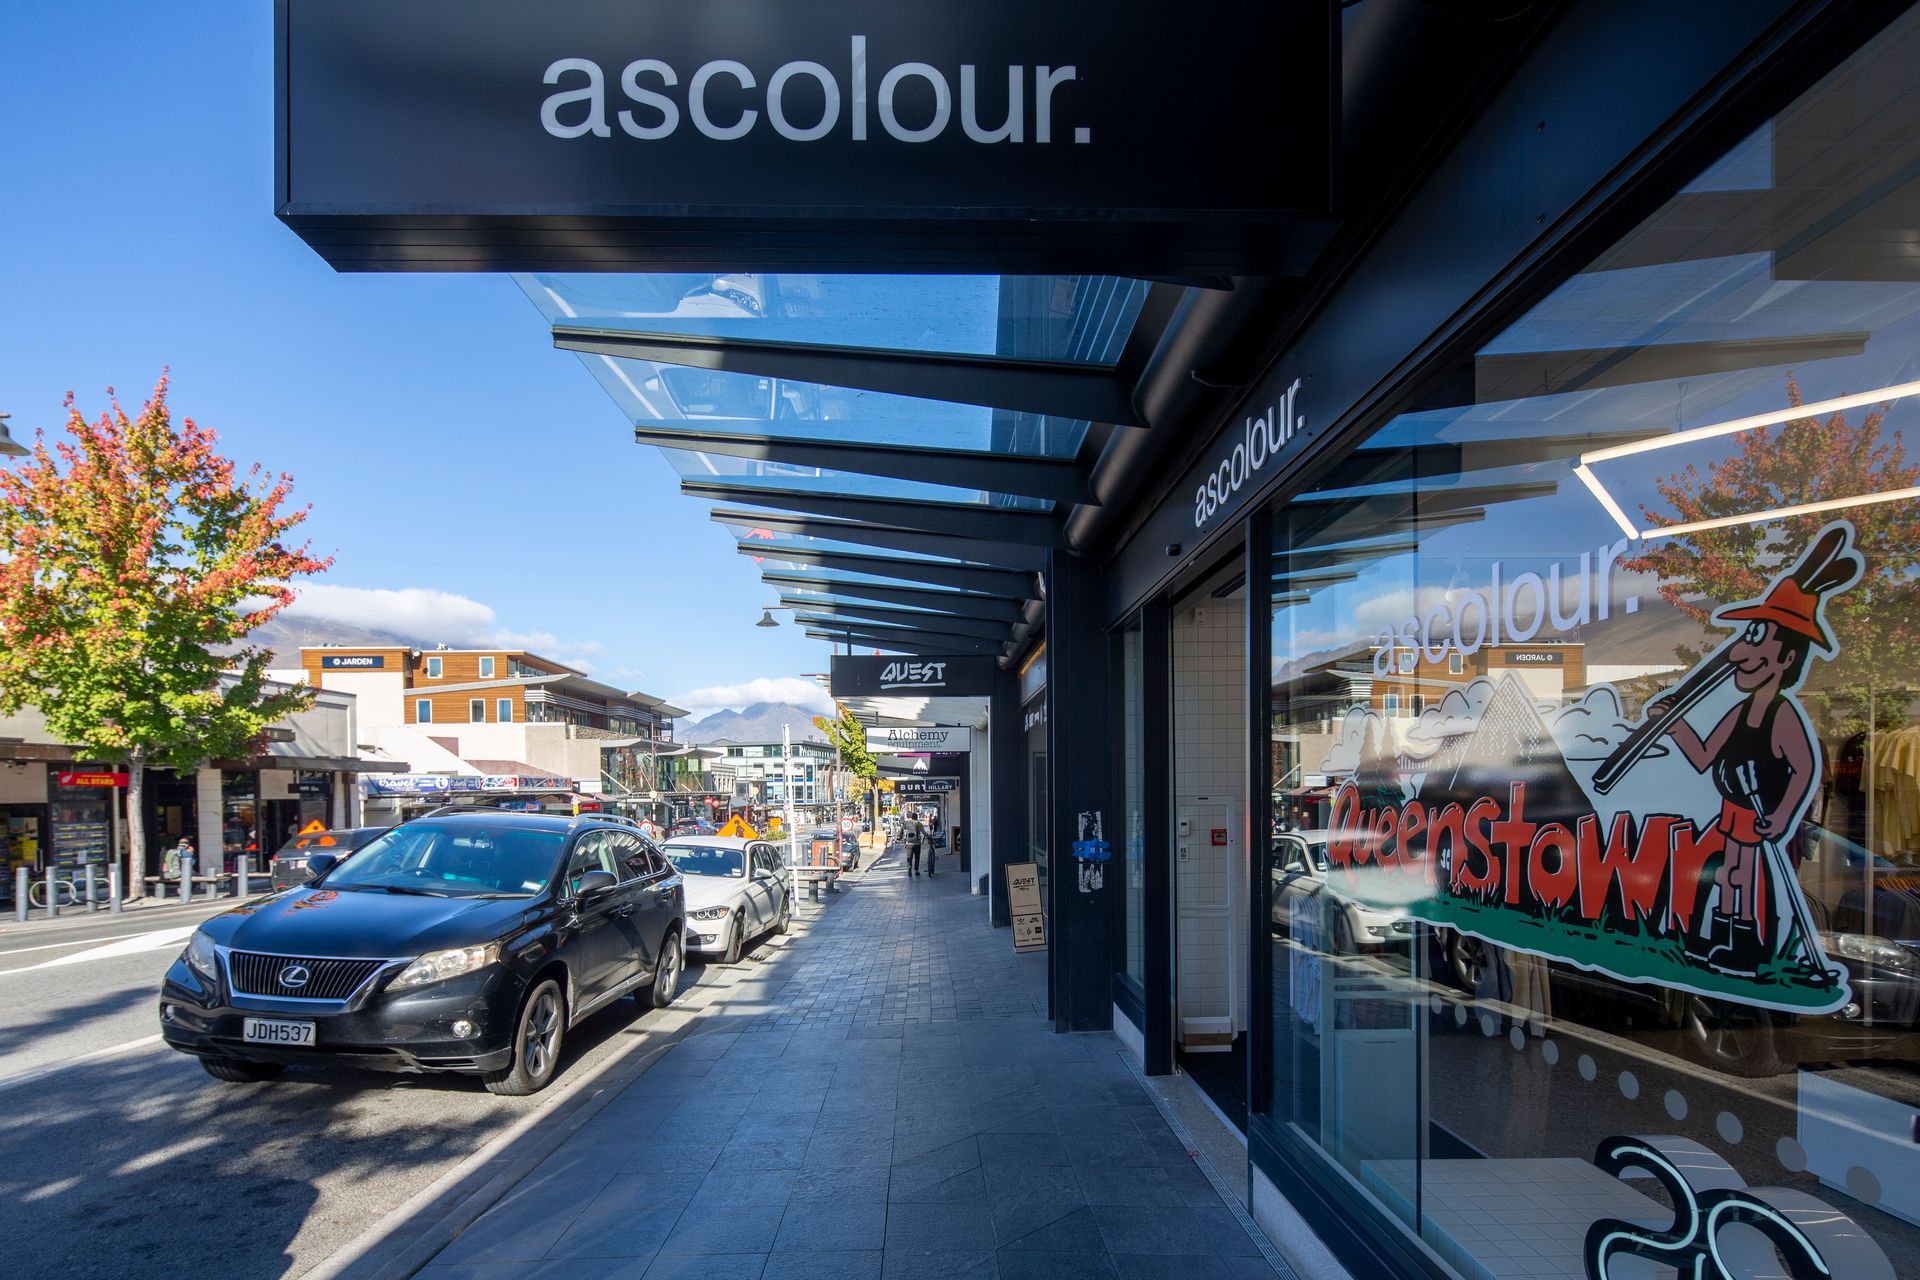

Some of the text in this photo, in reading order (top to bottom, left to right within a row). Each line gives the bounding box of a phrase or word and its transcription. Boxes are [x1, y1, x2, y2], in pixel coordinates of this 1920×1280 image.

[540, 35, 1091, 144] ascolour.
[1195, 378, 1306, 528] ascolour.
[1373, 538, 1639, 679] ascolour.
[341, 658, 373, 666] JARDEN
[880, 662, 947, 682] QUEST
[887, 729, 949, 743] Alchemy
[1012, 877, 1036, 886] QUEST
[246, 1022, 312, 1043] JDH537
